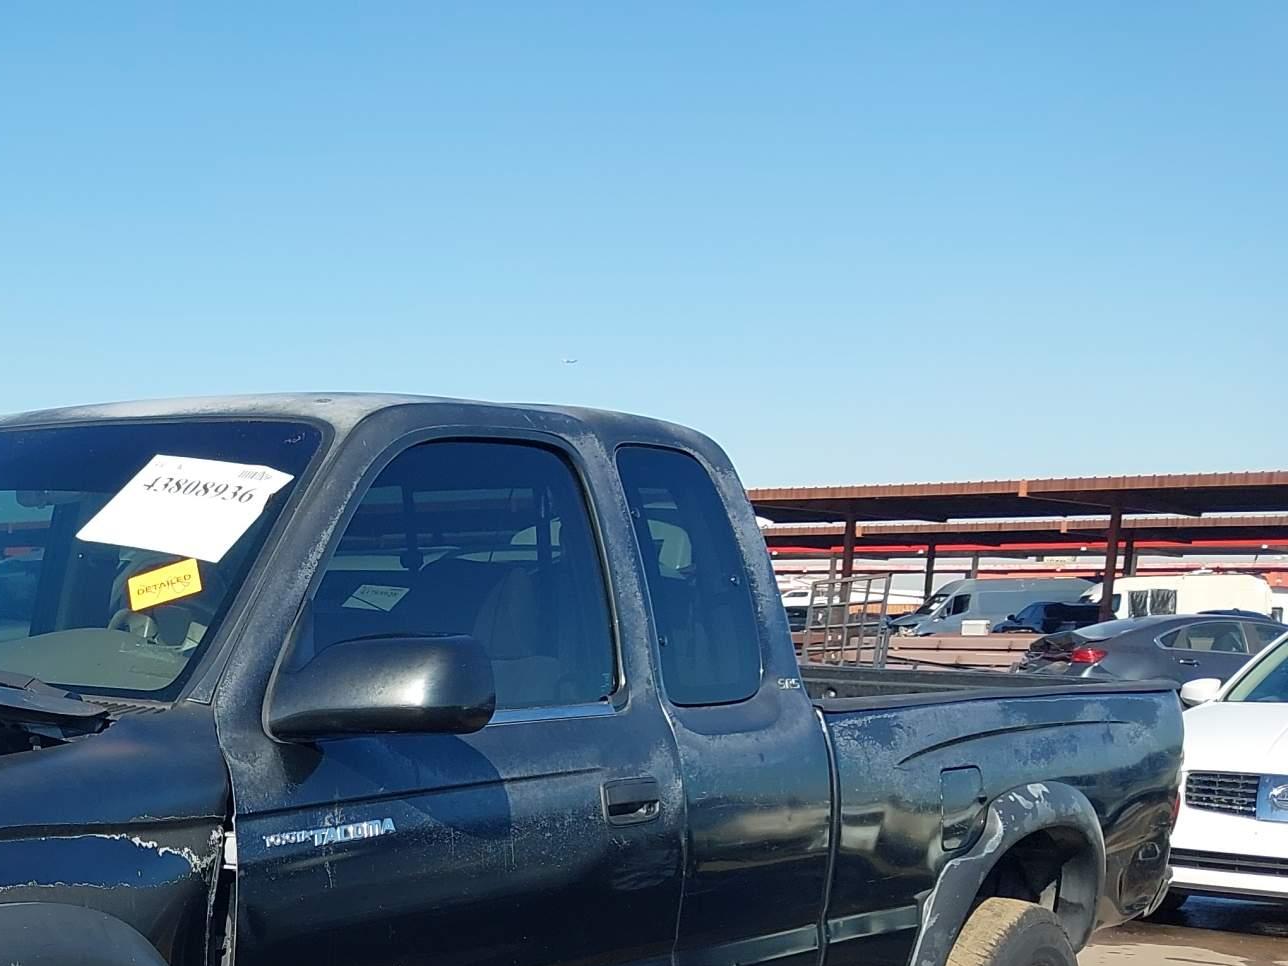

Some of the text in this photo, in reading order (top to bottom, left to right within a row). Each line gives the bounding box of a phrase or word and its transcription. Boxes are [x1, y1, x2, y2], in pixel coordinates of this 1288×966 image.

[143, 477, 256, 504] 43808936
[137, 573, 192, 597] DETAILED
[777, 678, 801, 690] SR5
[263, 817, 397, 848] TOYOTA TACOMA
